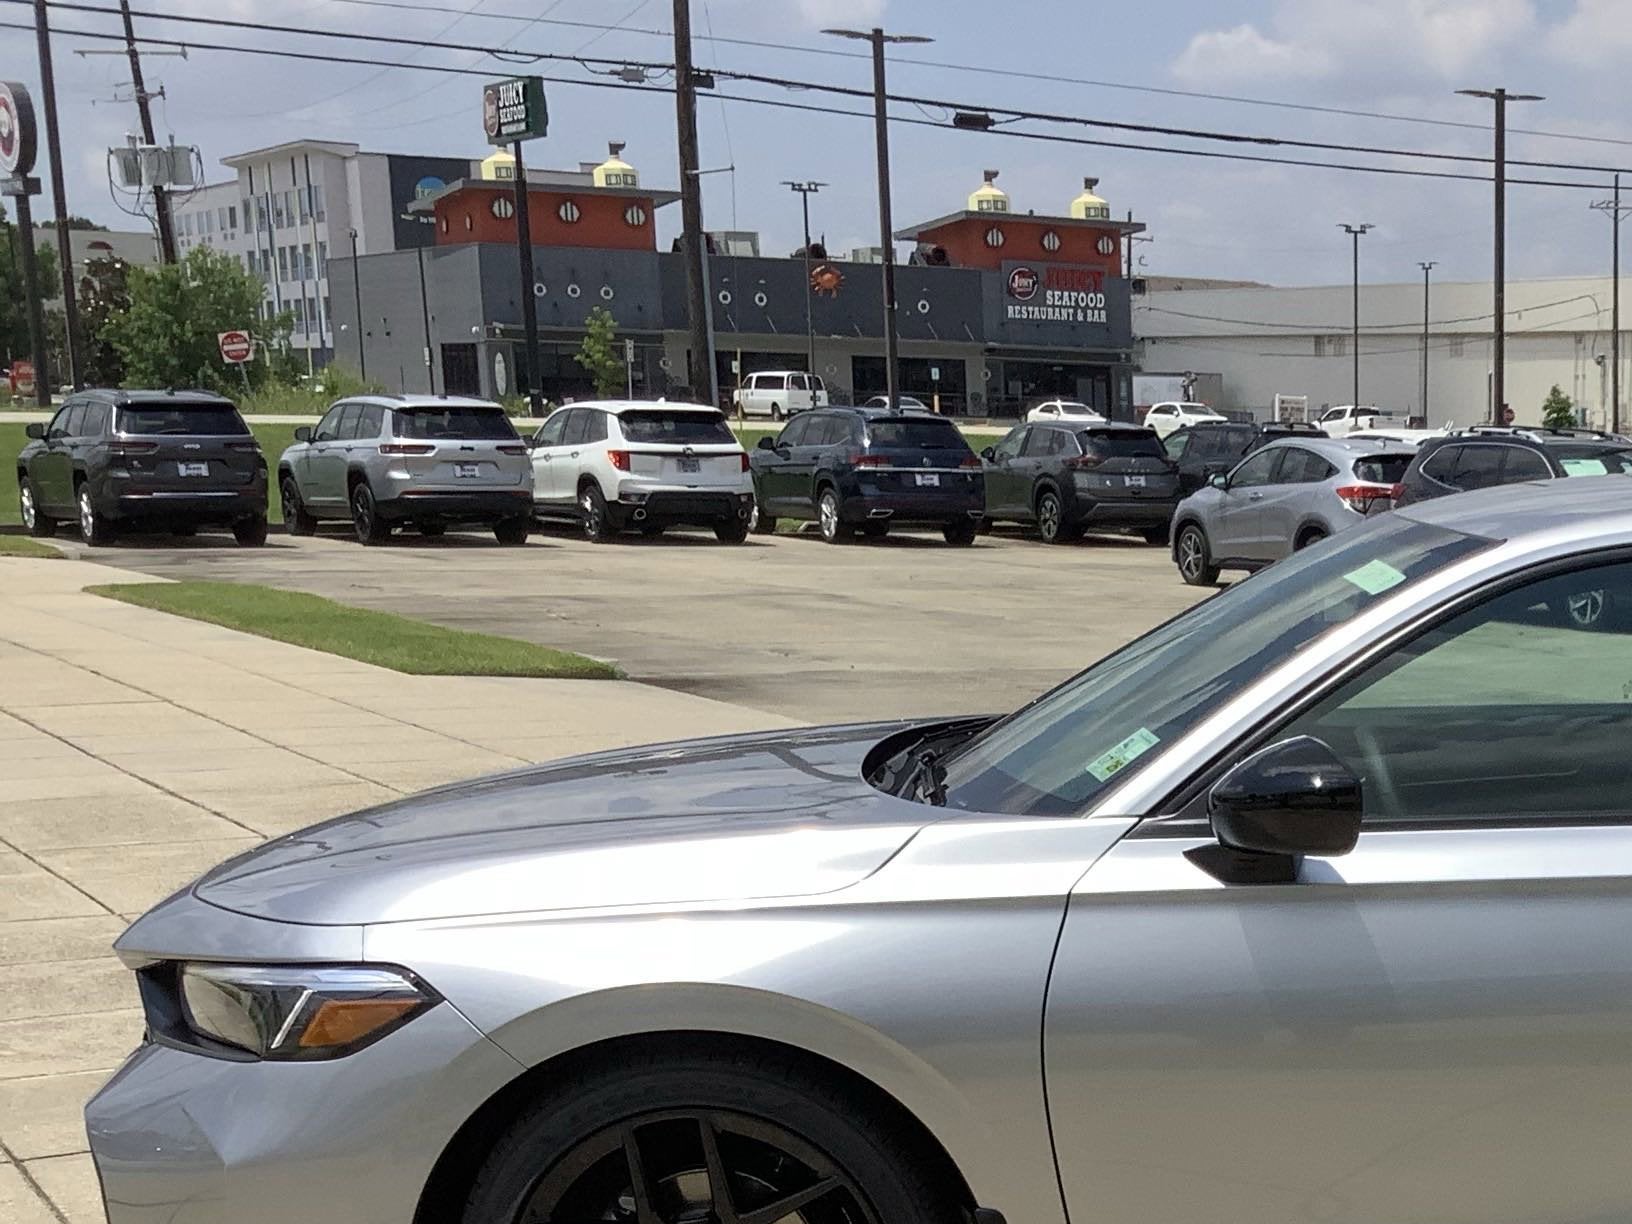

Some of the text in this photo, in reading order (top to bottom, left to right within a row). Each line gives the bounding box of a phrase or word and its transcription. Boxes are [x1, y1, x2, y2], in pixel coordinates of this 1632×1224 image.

[499, 81, 524, 107] JUICY
[1046, 290, 1105, 308] SEAFOOD
[1007, 305, 1107, 323] RESTAURANT & BAR
